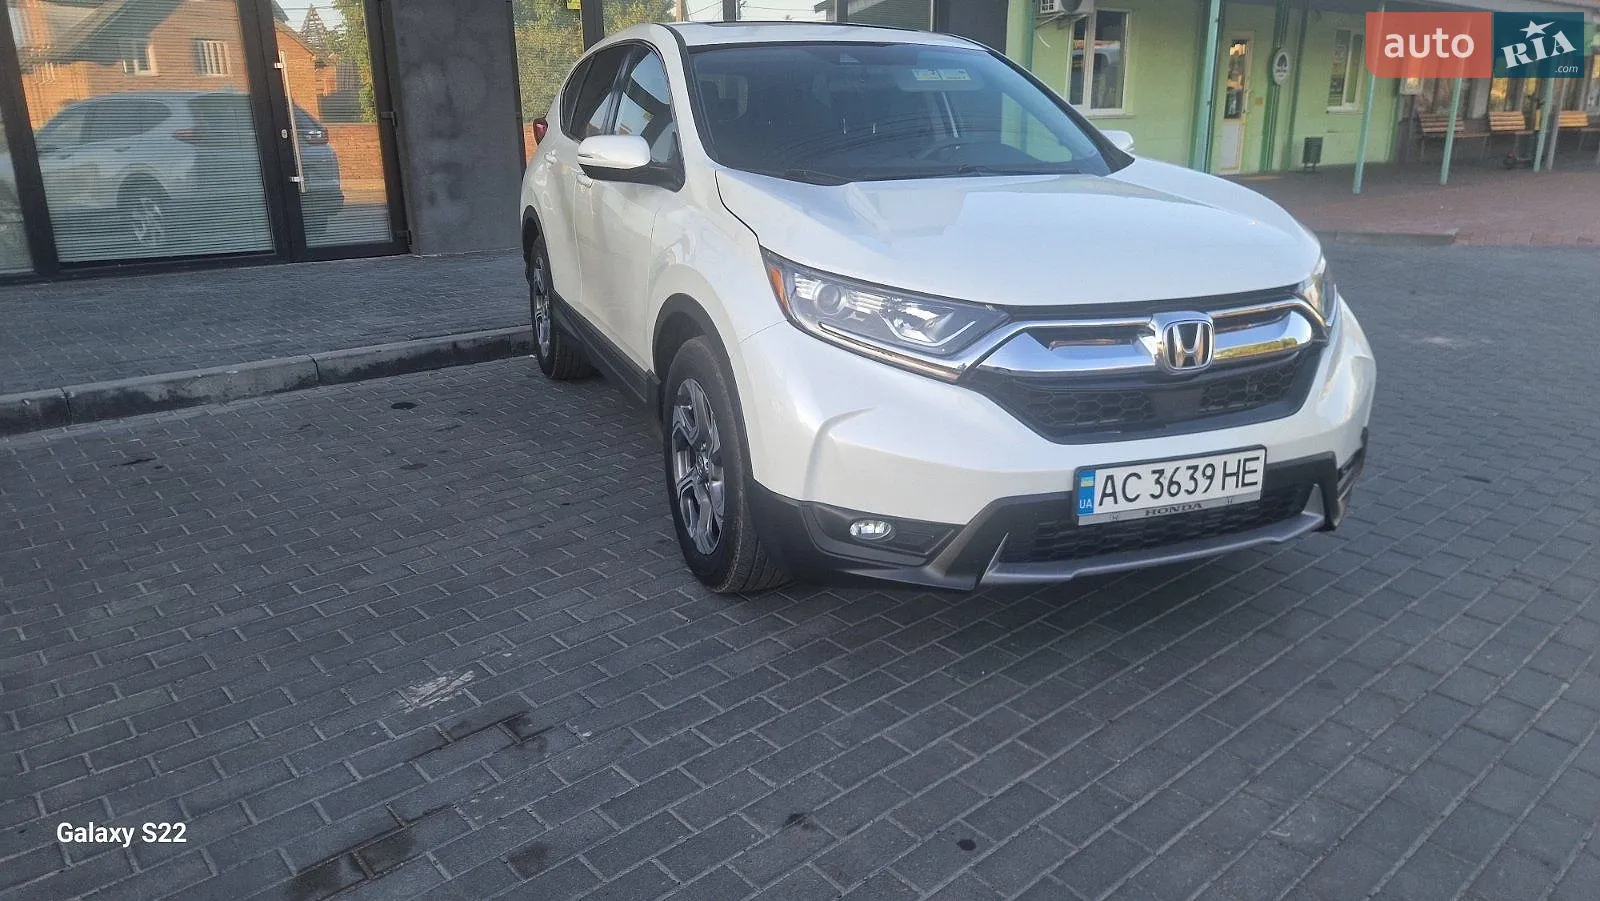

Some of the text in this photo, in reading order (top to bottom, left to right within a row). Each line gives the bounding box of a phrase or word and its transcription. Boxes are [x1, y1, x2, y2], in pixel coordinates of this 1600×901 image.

[1097, 456, 1261, 507] AC 3639 HE
[1079, 498, 1093, 510] UA
[1144, 501, 1205, 517] HONDA
